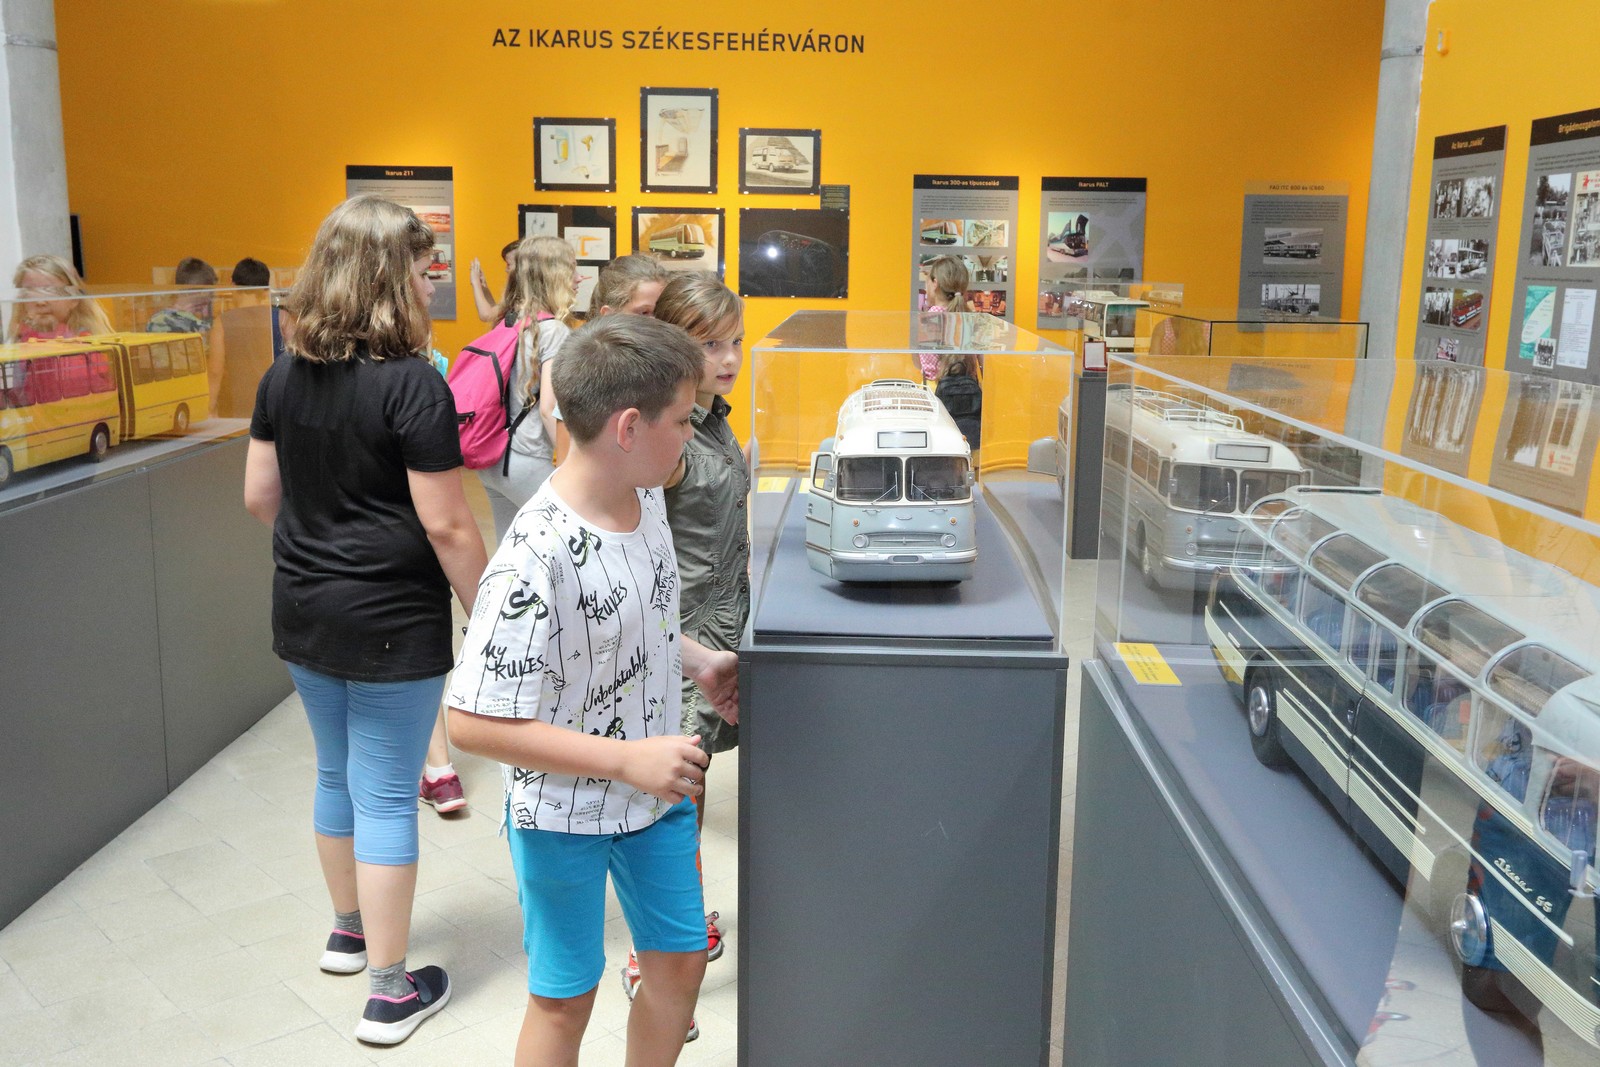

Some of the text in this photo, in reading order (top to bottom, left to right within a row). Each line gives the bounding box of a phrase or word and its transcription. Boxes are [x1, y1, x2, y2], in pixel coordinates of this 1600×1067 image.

[492, 25, 865, 54] AZ IKARUS SZÉKESFEHÉRVÁRON
[1535, 895, 1553, 913] 55
